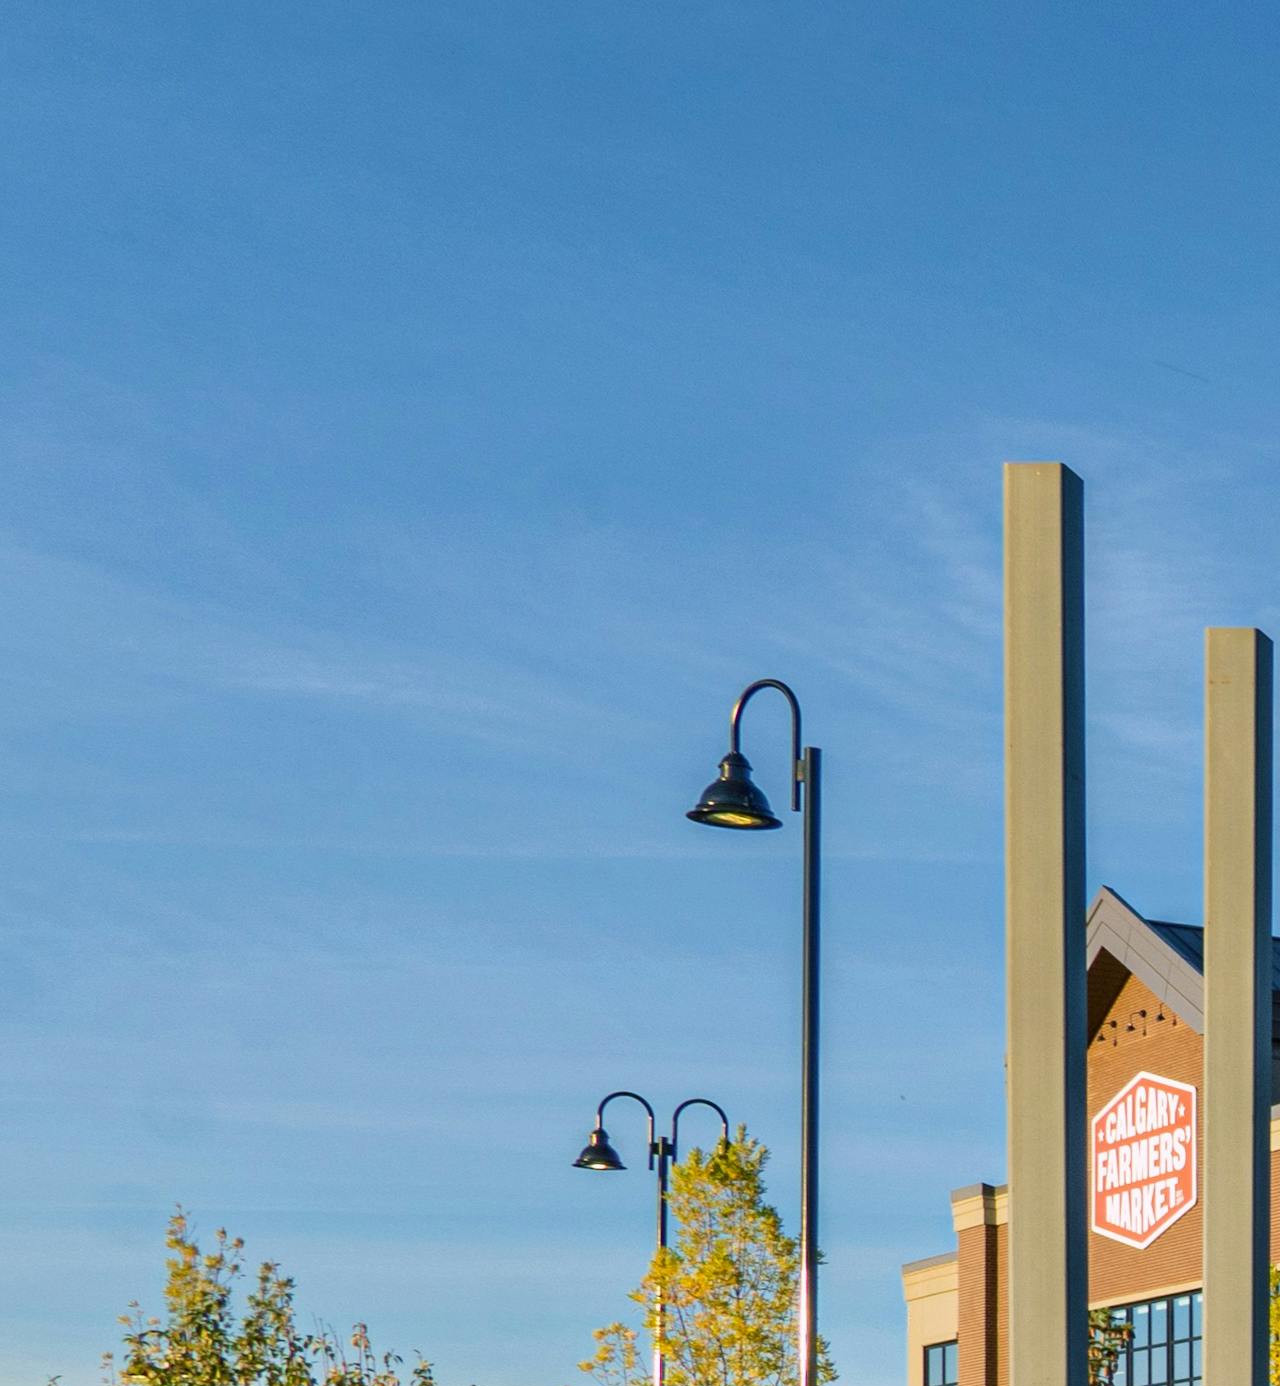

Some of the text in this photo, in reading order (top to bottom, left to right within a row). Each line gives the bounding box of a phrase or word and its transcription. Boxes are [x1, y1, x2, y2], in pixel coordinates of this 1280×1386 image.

[1105, 1086, 1180, 1144] CALGARY
[1097, 1125, 1191, 1193] FARMERS'
[1105, 1177, 1179, 1235] MARKET
